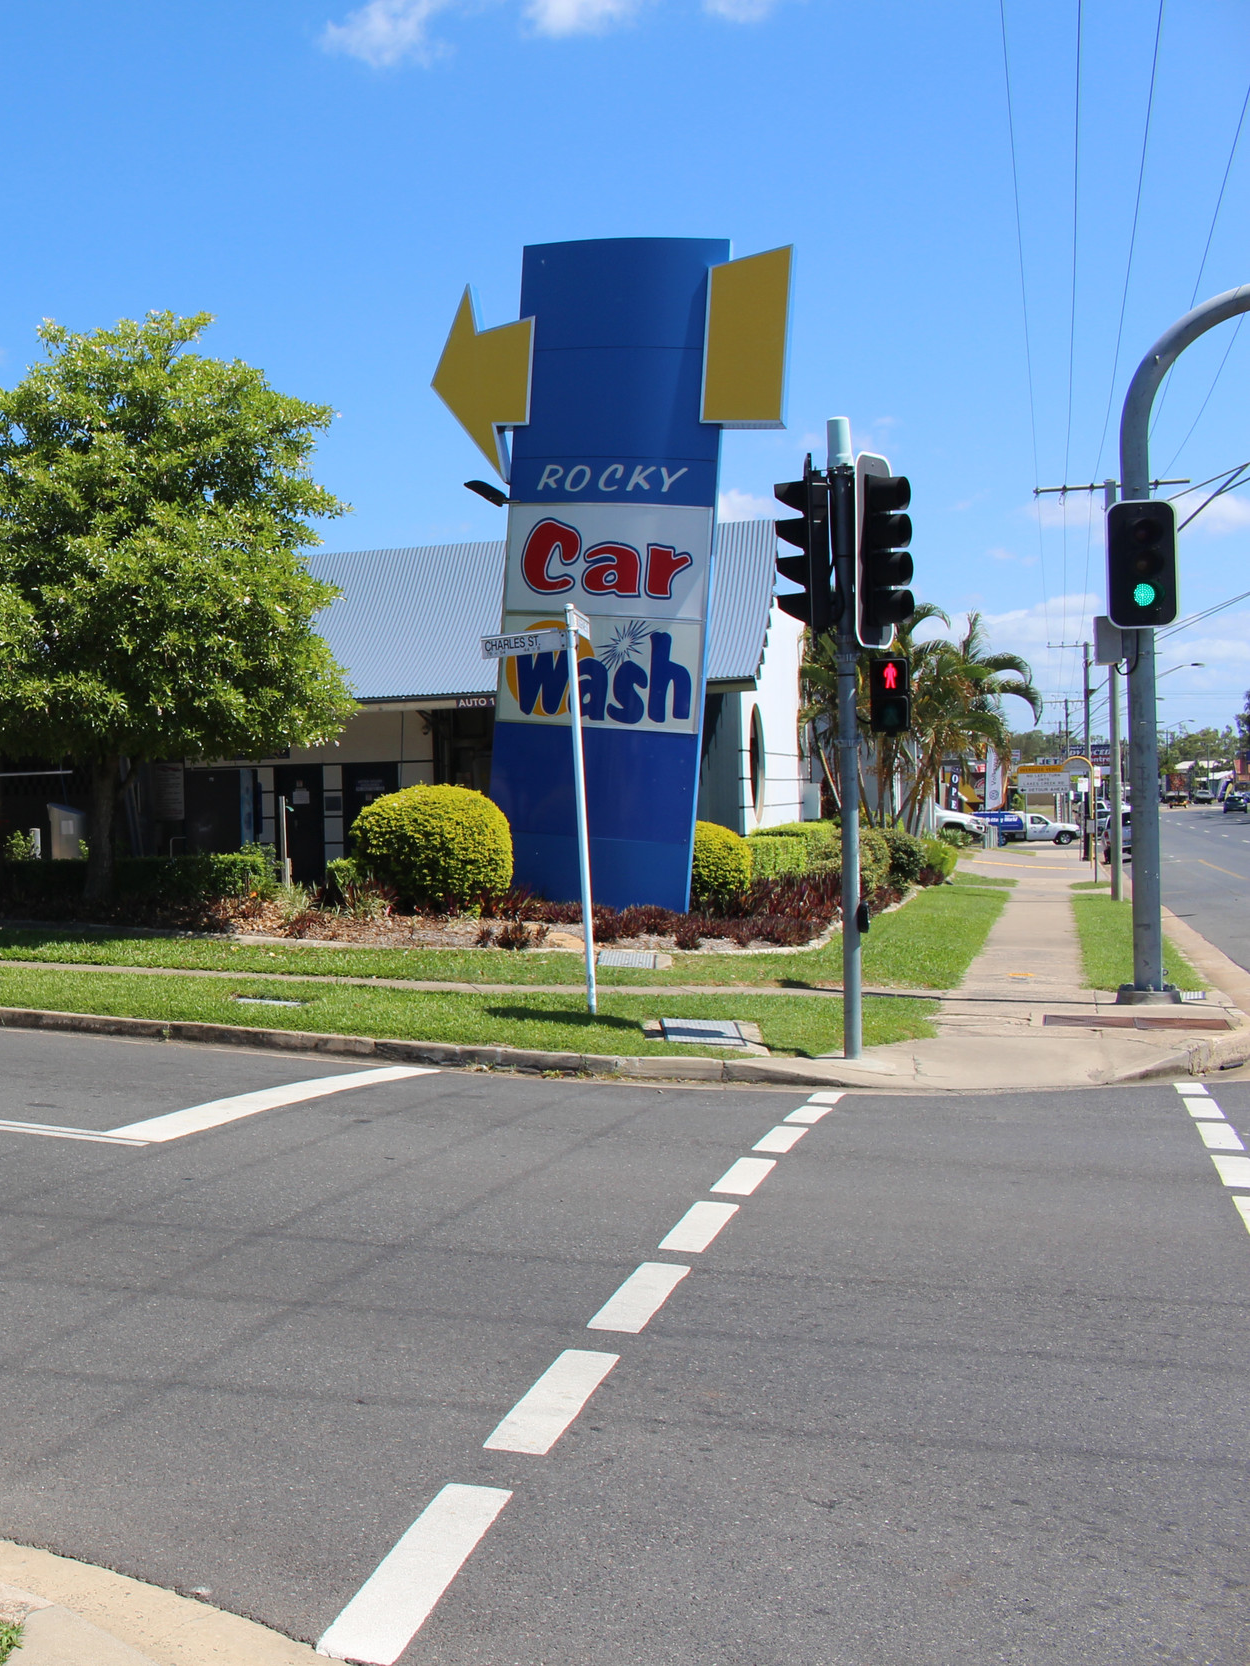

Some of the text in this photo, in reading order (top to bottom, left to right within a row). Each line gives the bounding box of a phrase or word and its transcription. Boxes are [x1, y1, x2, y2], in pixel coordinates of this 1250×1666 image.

[536, 463, 689, 492] ROCKY
[521, 517, 693, 600] Car
[484, 635, 541, 652] CHARLES ST.
[516, 632, 692, 724] Wash
[458, 697, 495, 708] AUTO 1
[1039, 758, 1059, 766] JET
[951, 774, 959, 810] OPE
